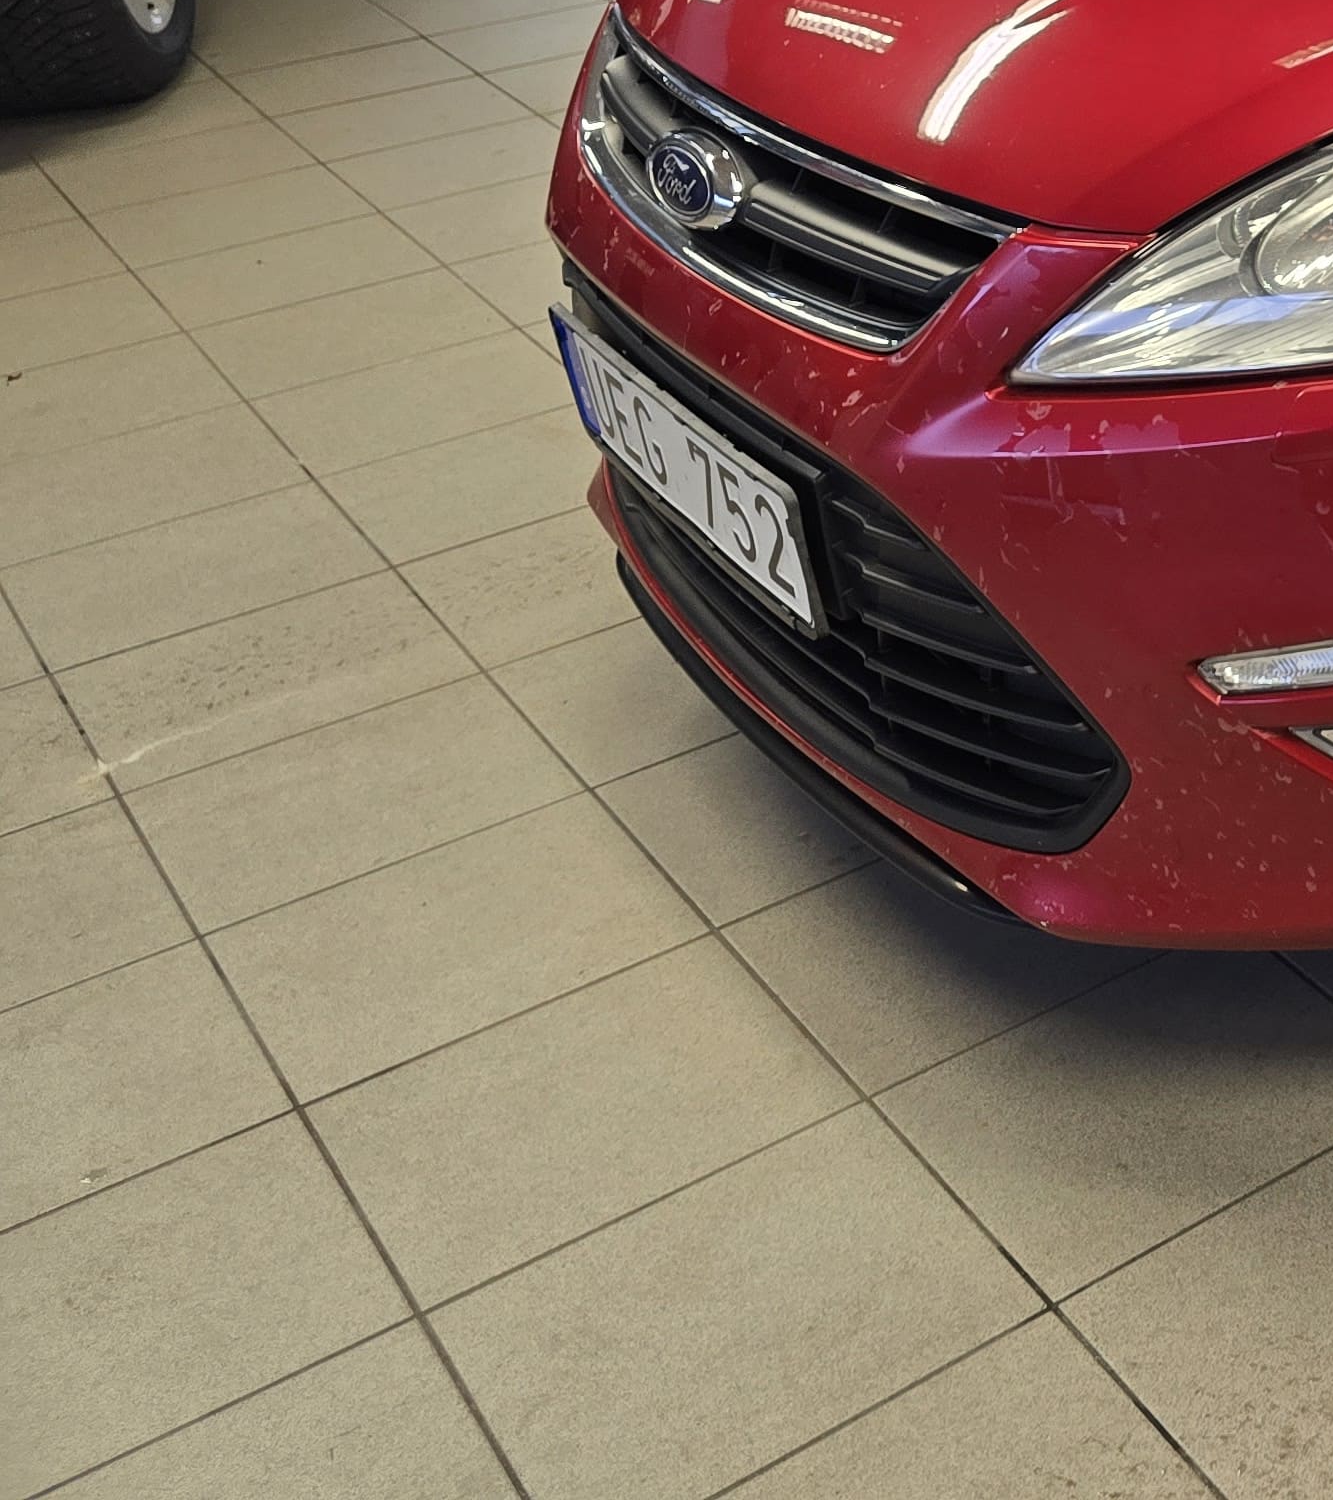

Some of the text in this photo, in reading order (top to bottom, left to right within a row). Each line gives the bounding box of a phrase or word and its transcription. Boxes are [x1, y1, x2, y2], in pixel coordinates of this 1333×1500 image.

[657, 152, 696, 205] Ford
[579, 347, 797, 599] UEG 752
